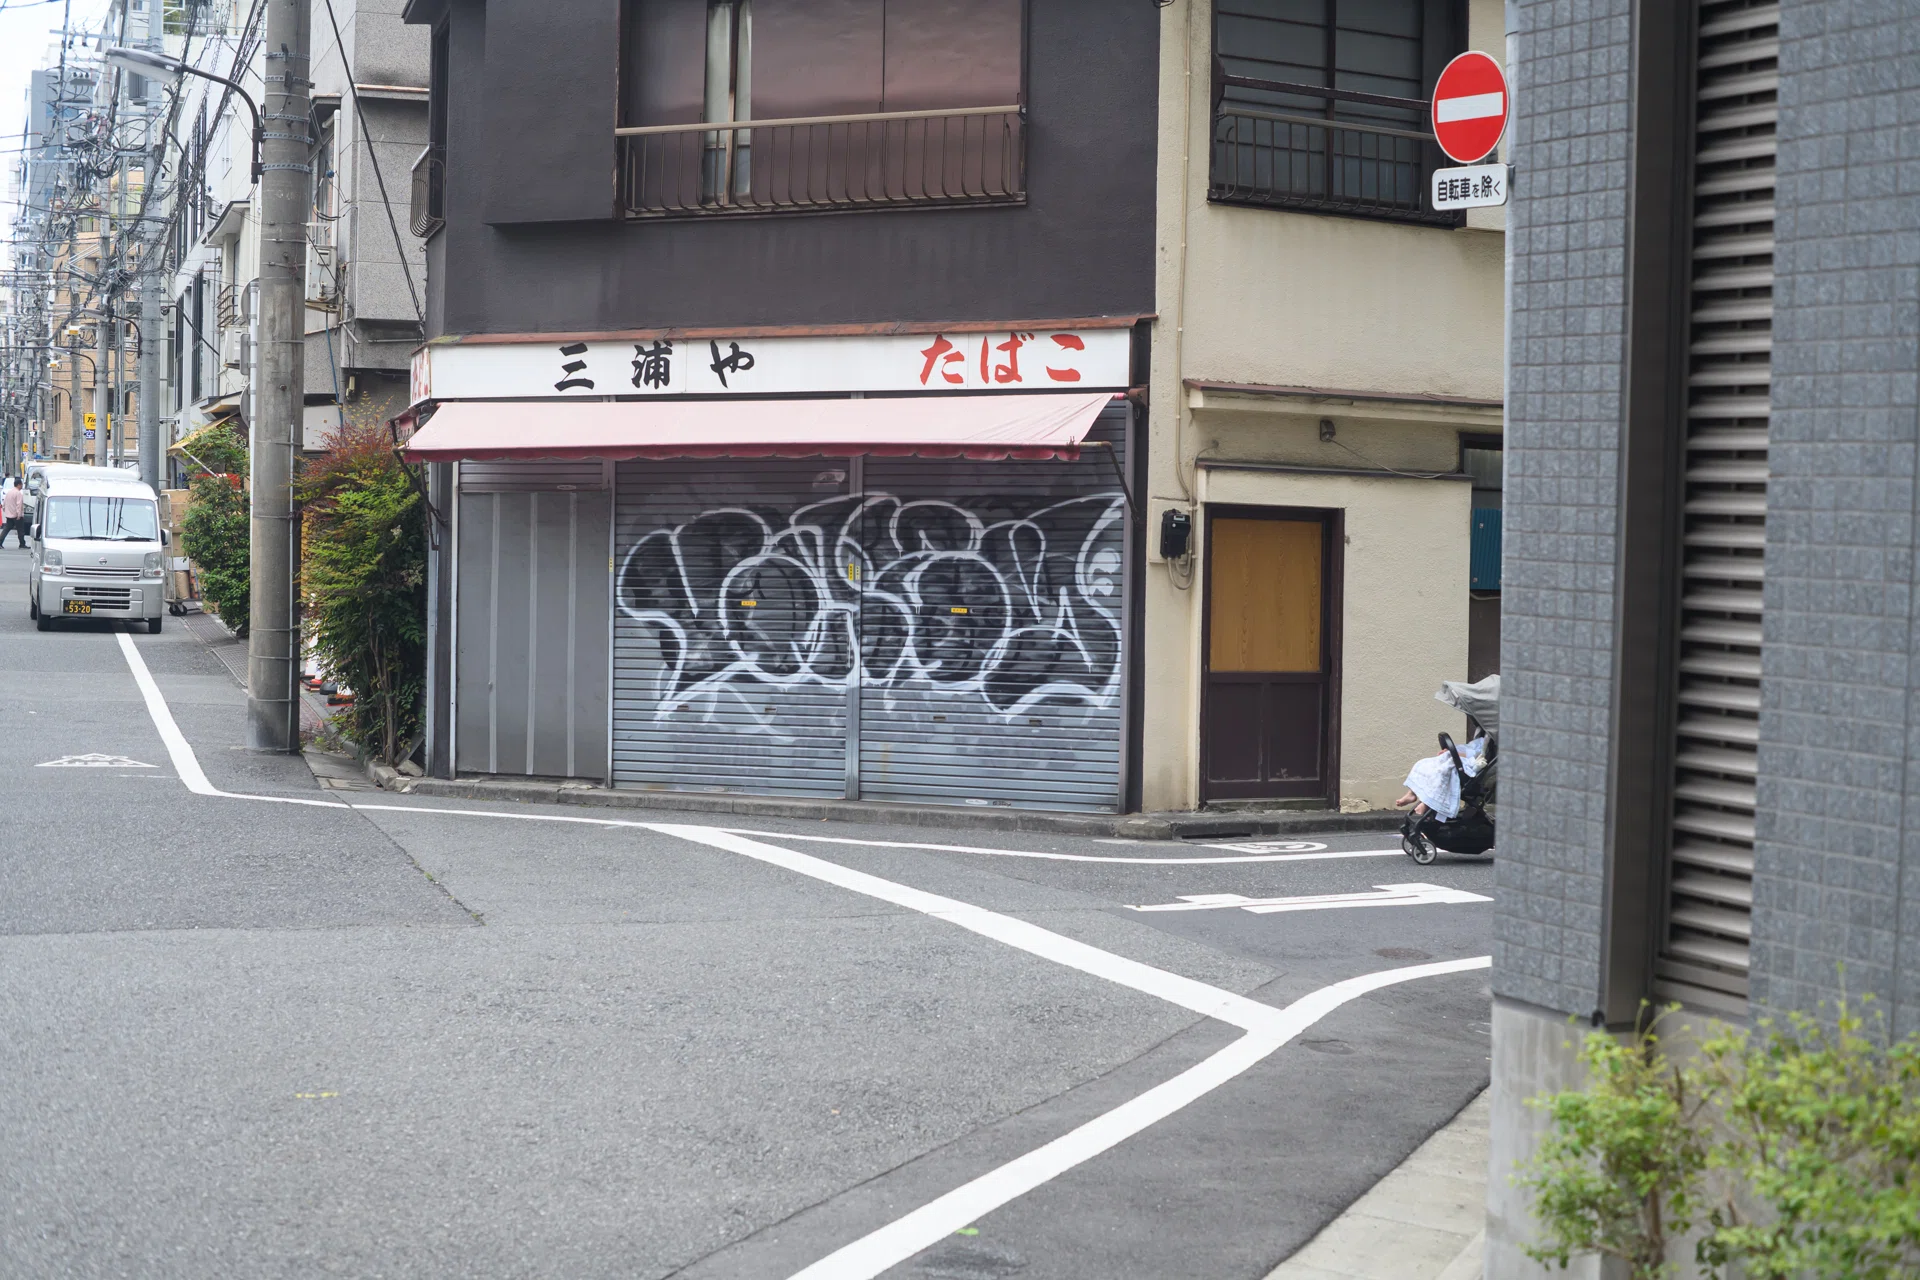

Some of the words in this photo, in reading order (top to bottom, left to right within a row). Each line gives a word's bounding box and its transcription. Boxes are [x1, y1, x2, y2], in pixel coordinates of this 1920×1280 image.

[1438, 175, 1501, 202] 自転車を除く
[554, 340, 755, 392] 三浦や
[920, 332, 1086, 386] たばこ
[69, 605, 91, 614] 53-20
